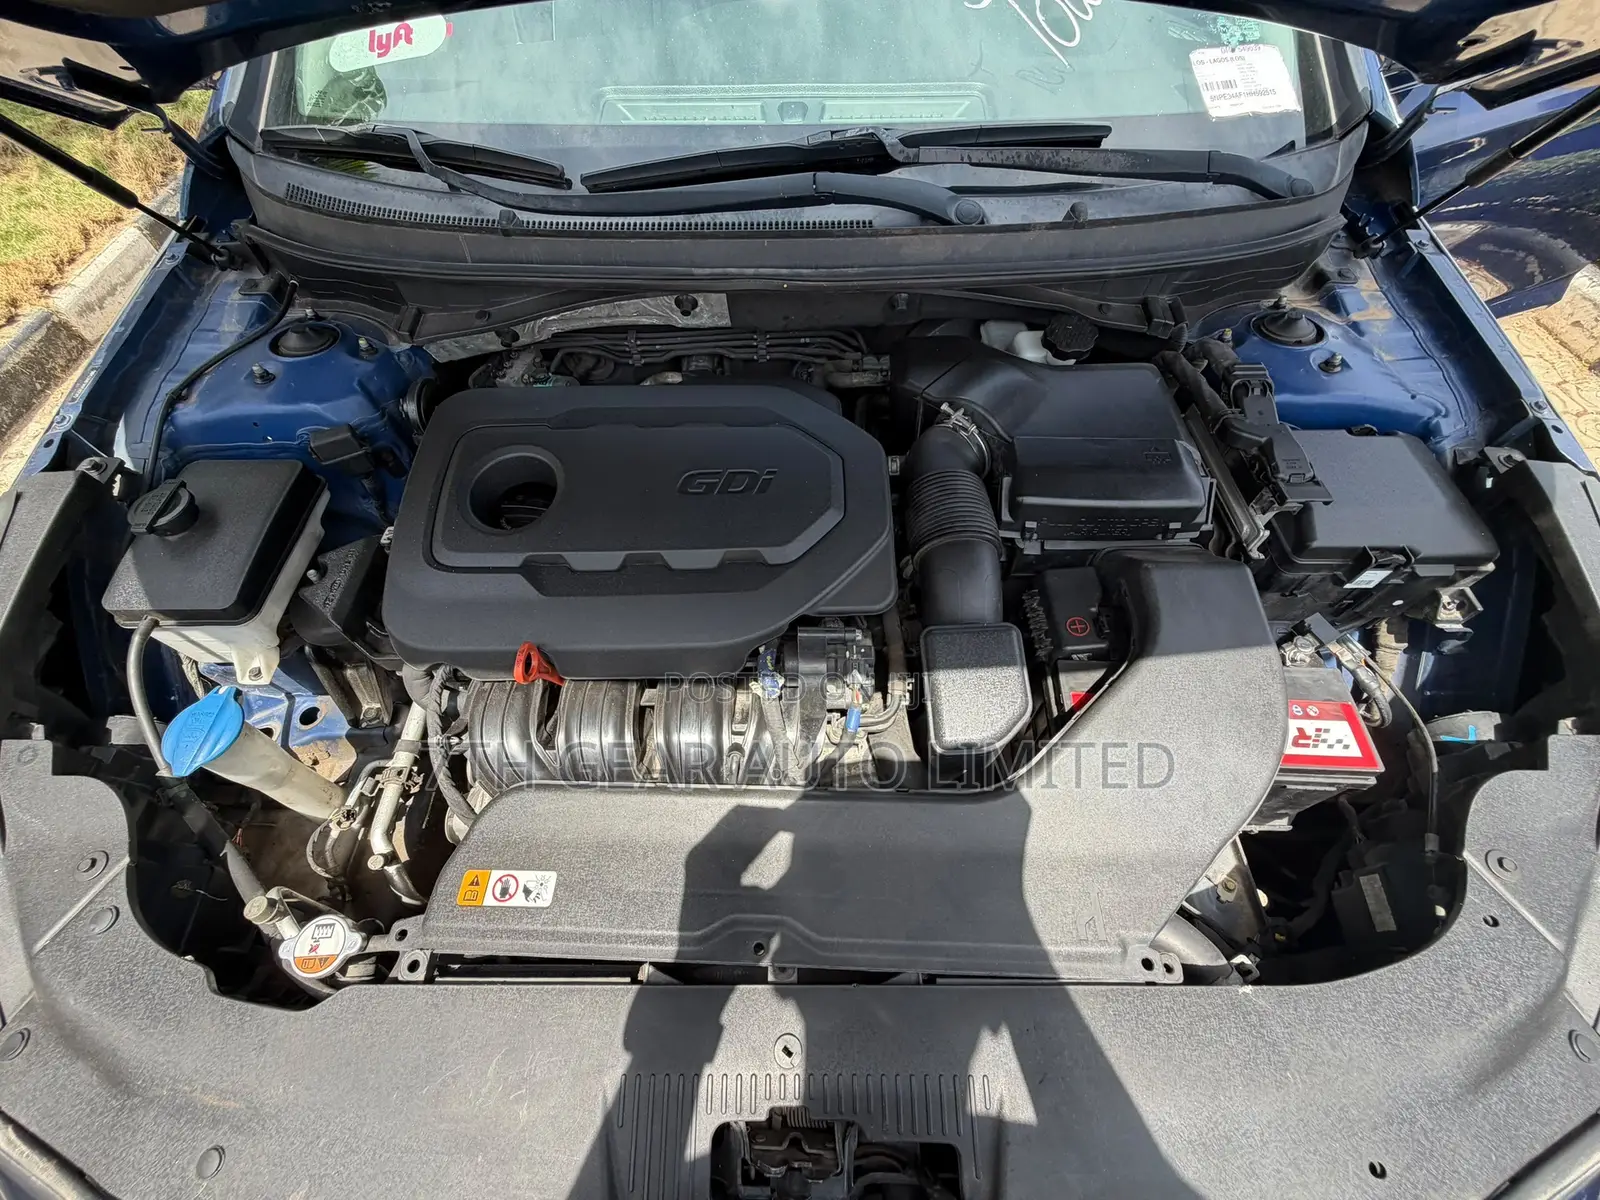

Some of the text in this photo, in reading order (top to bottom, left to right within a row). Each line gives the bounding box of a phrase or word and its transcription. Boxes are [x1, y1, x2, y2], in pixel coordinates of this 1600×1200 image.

[368, 22, 413, 58] lyft
[1210, 56, 1229, 65] LAGOS
[676, 467, 779, 496] GDi
